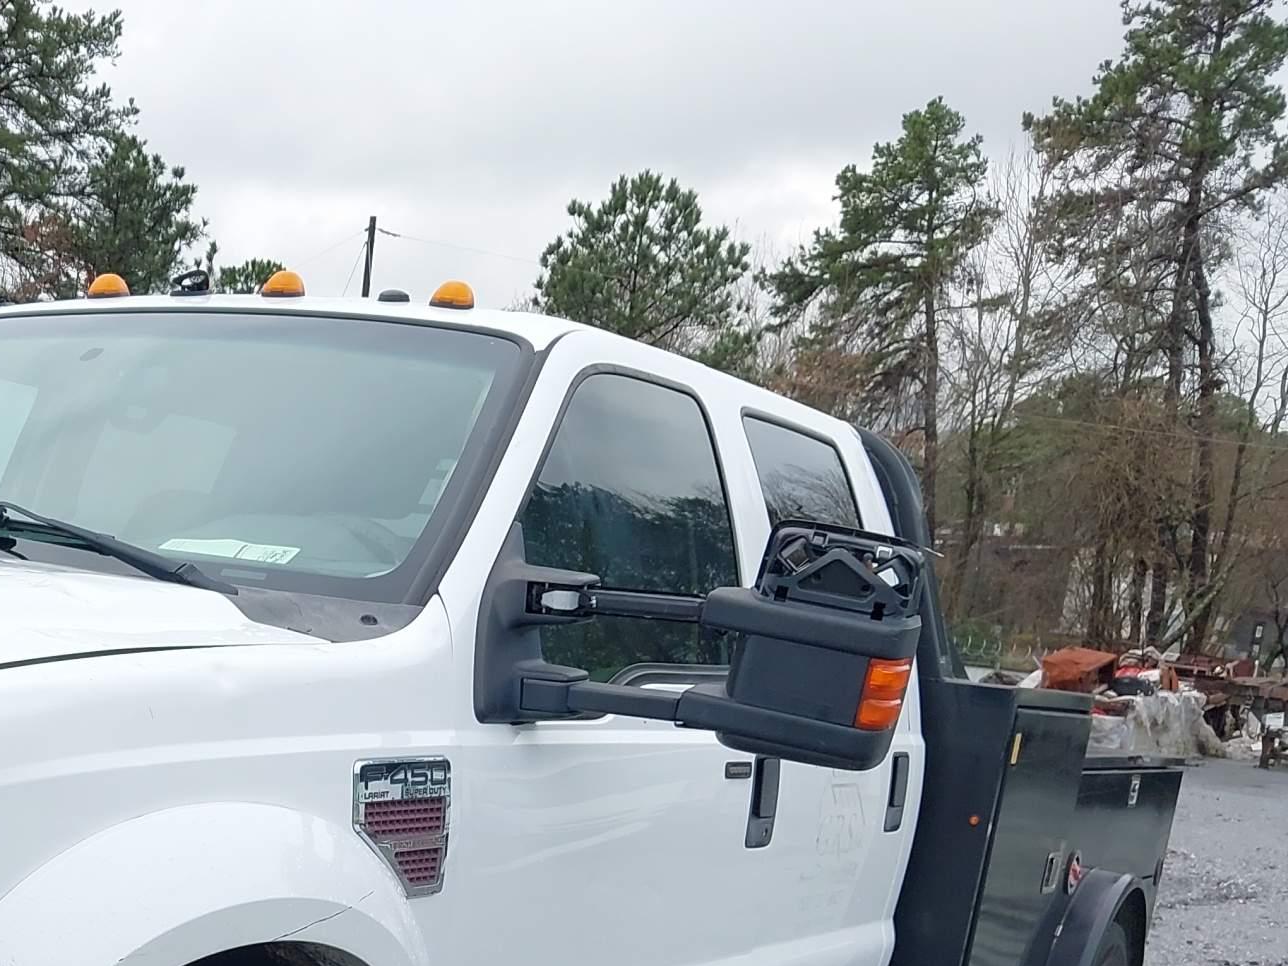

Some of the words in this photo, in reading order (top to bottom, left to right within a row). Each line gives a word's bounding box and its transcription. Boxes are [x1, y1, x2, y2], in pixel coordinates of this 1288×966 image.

[363, 790, 390, 800] LARIAT
[404, 787, 428, 797] SUPER
[428, 785, 447, 795] DUTY
